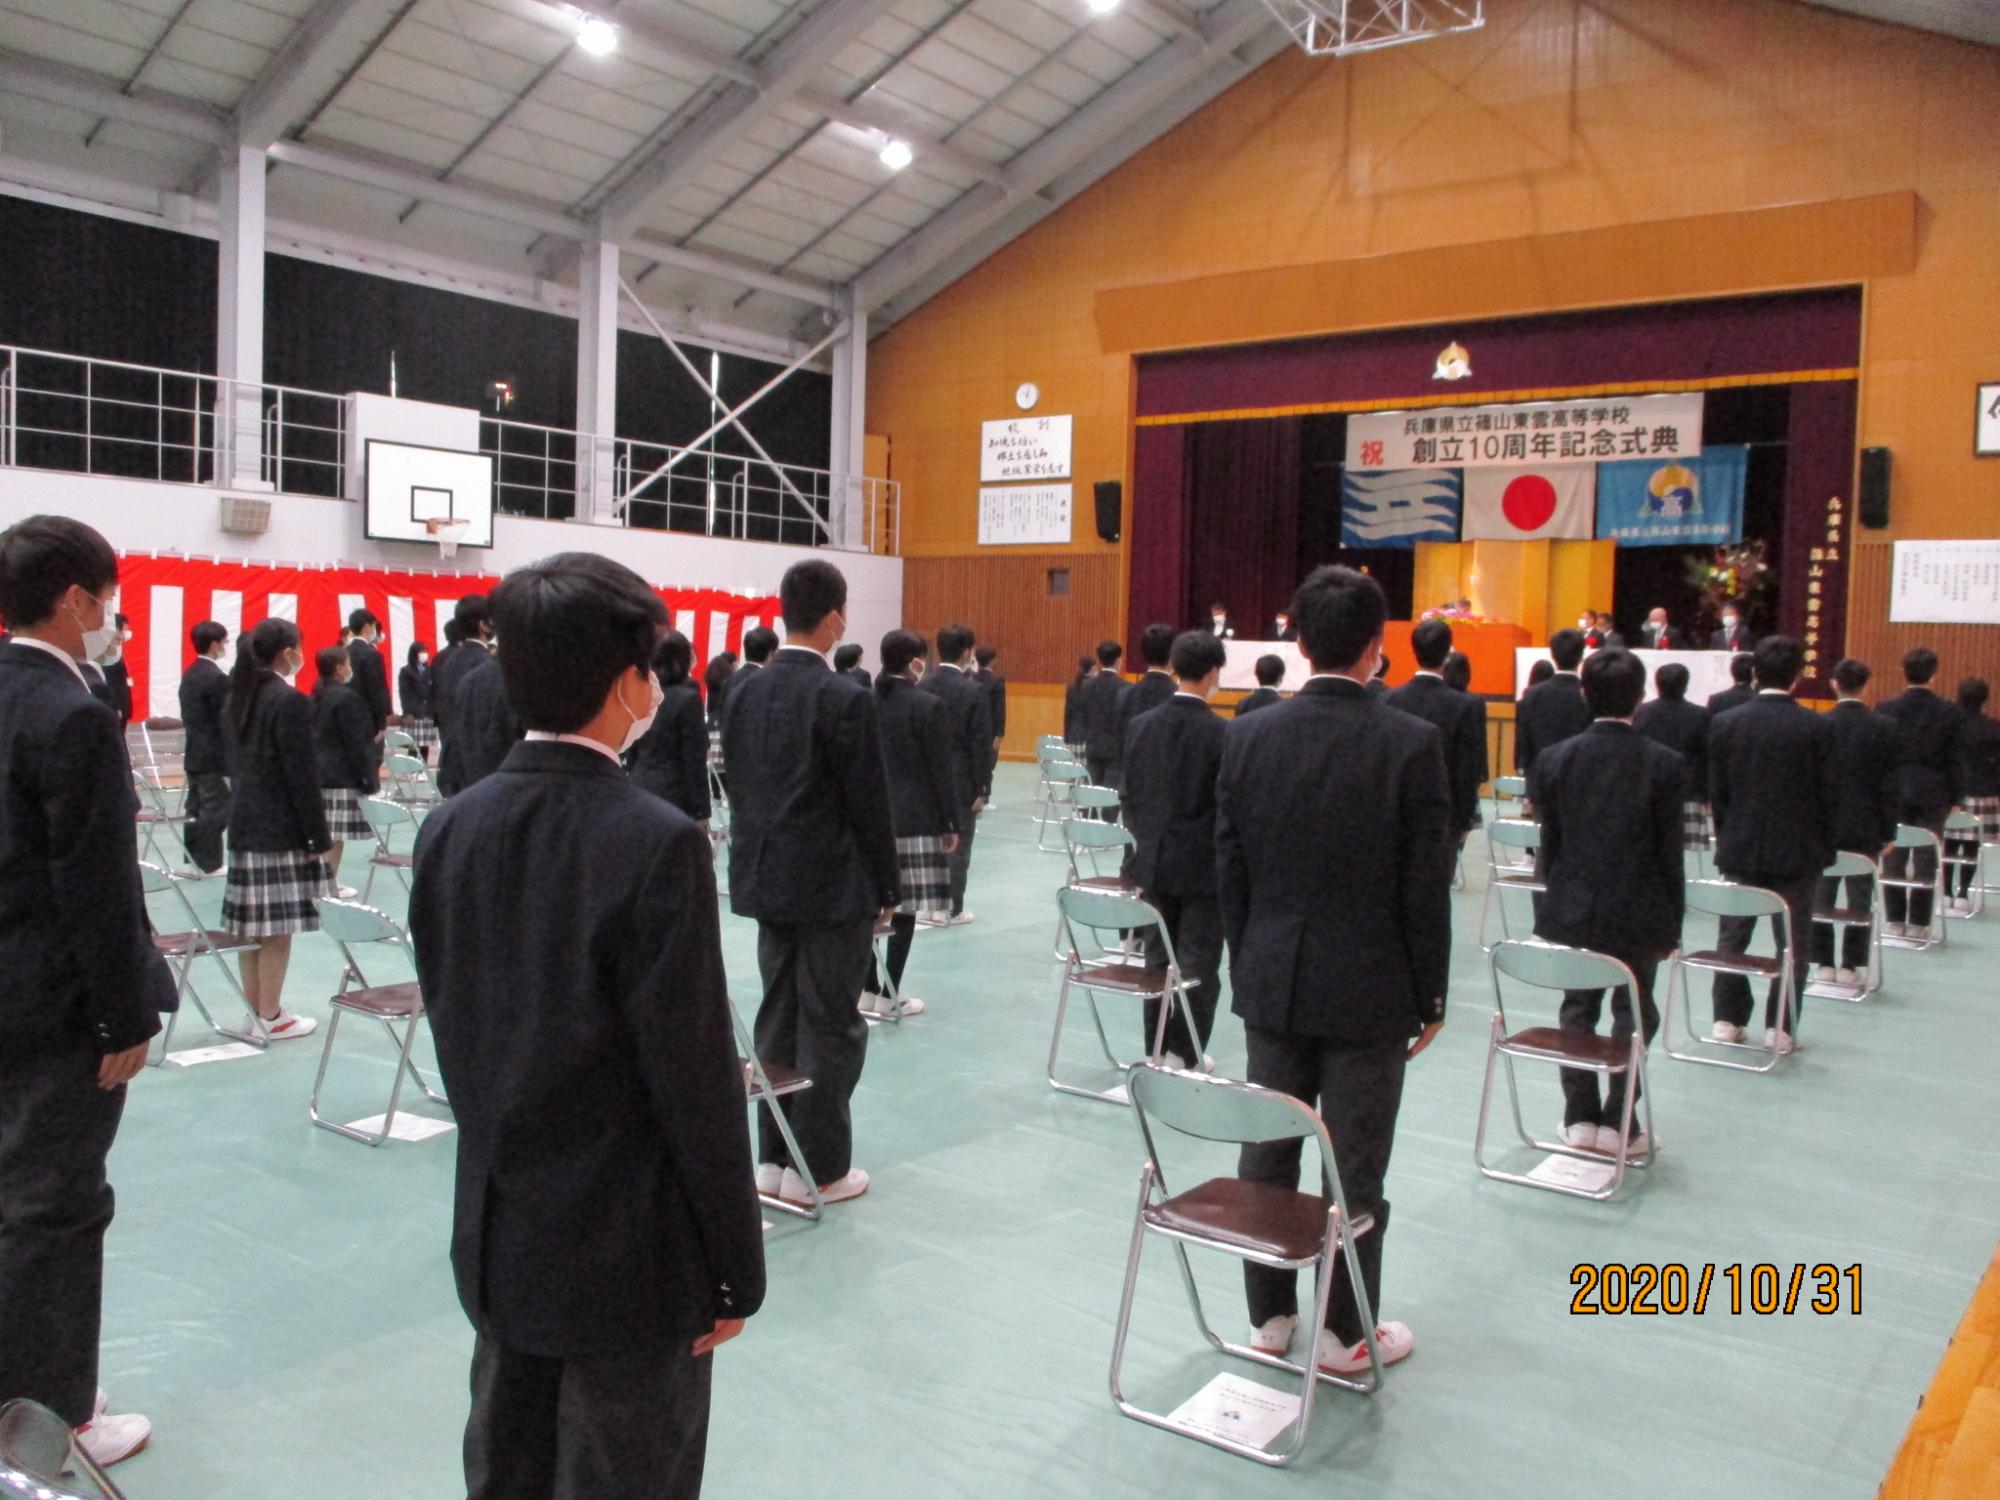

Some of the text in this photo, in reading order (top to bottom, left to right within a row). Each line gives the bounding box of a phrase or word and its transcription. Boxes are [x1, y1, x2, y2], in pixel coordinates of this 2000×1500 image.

[1403, 405, 1631, 434] 兵庫県立篠山東雲高等学校
[1360, 440, 1384, 467] 祝
[1412, 425, 1679, 464] 創立10周年記念式典
